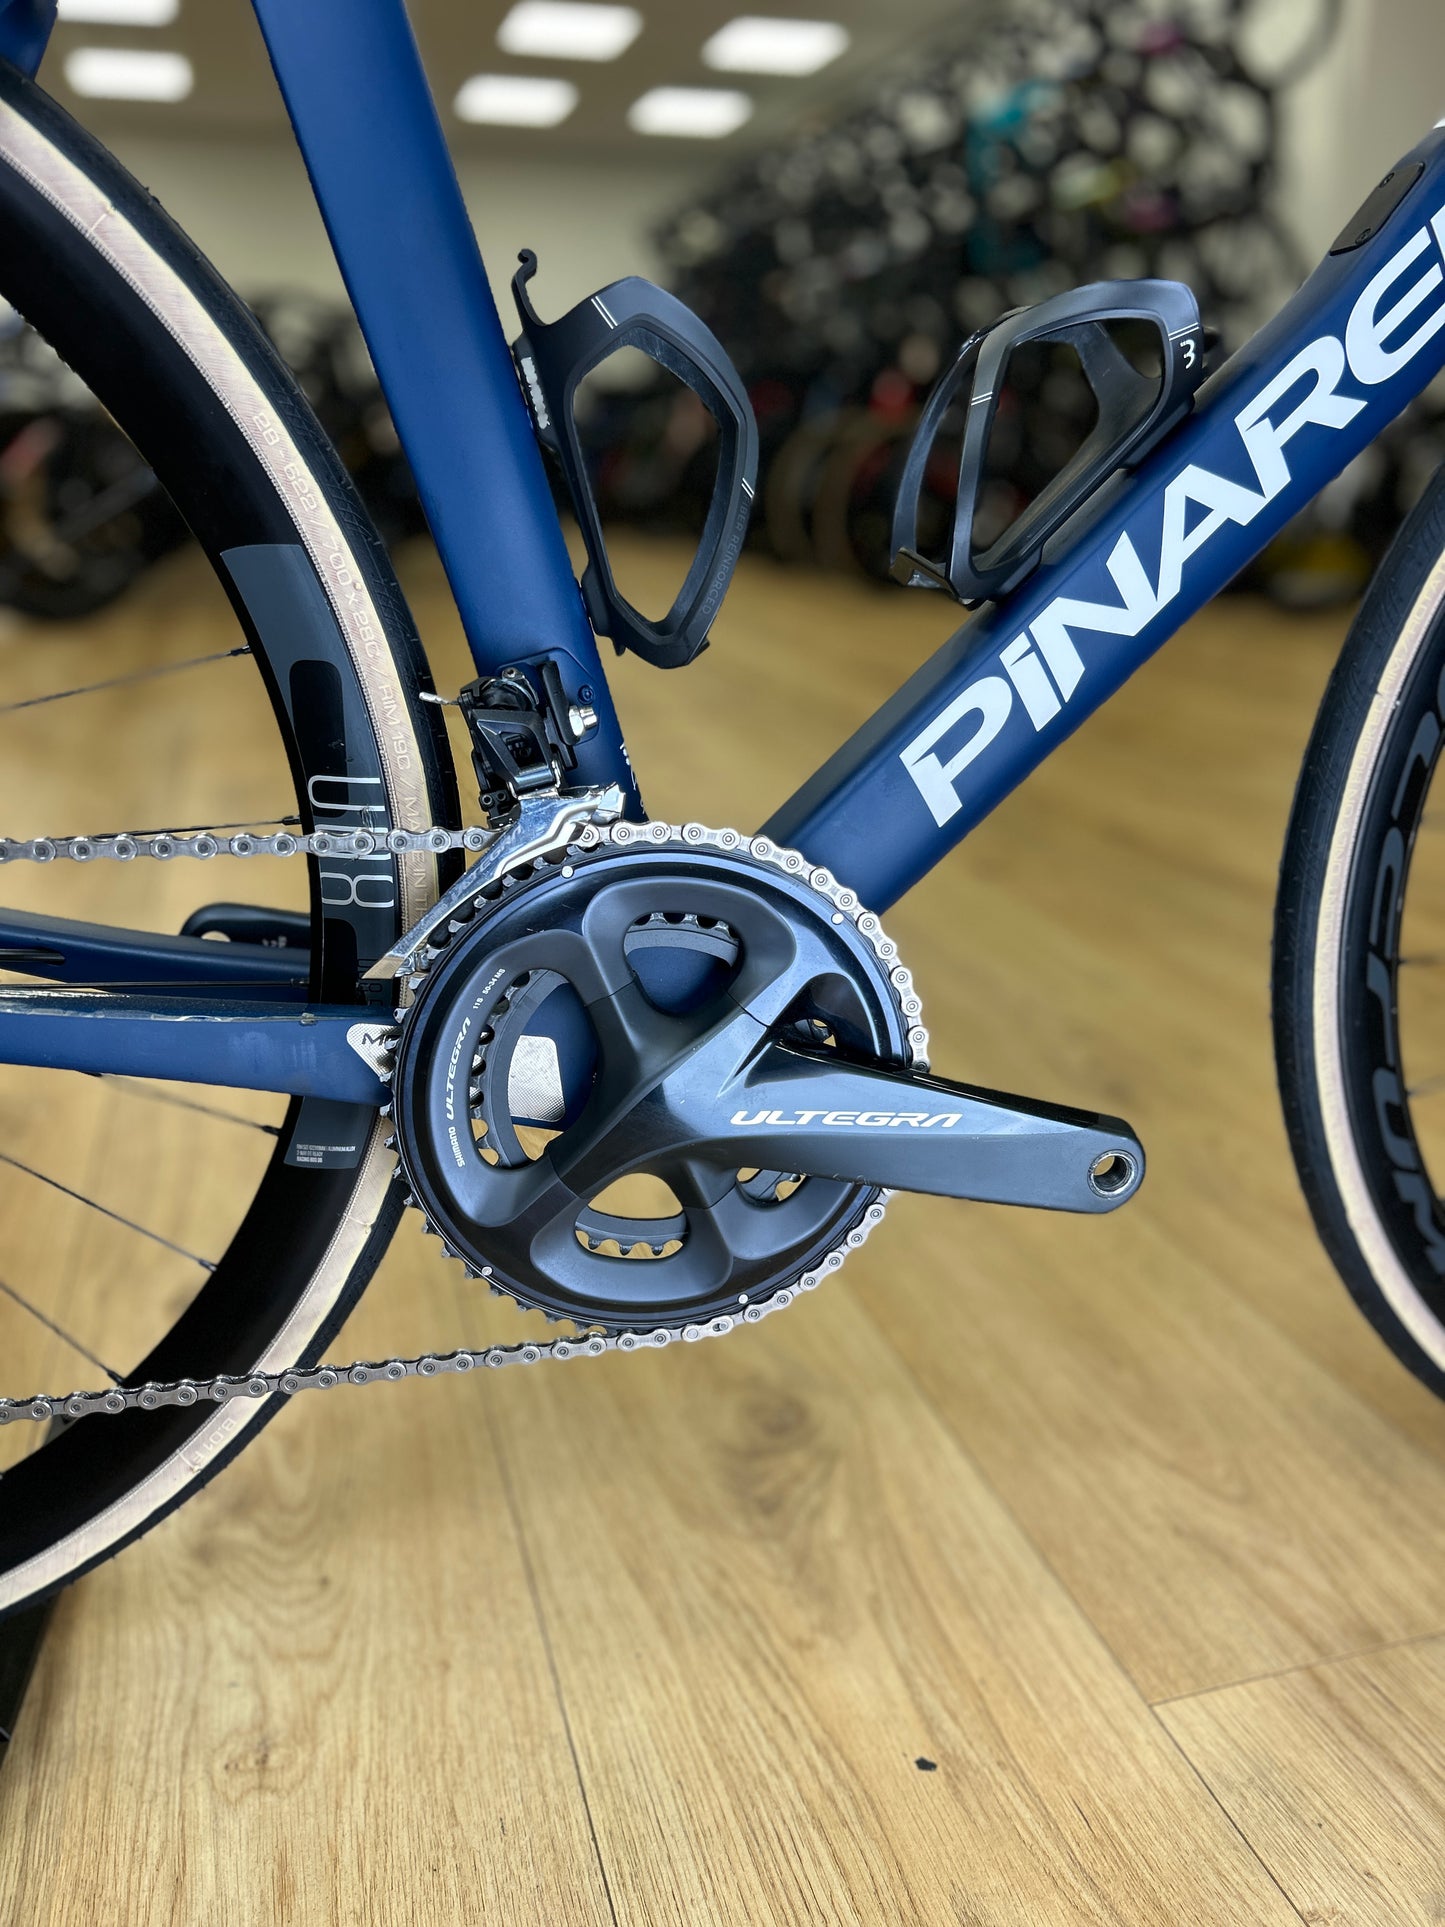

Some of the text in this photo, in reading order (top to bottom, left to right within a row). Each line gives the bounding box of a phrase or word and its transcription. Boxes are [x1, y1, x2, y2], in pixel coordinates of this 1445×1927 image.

[899, 203, 1445, 828] PiNARE
[446, 1017, 472, 1121] ULTEGRA
[448, 1126, 466, 1168] SHIMANO
[730, 1110, 963, 1128] ULTEGRA
